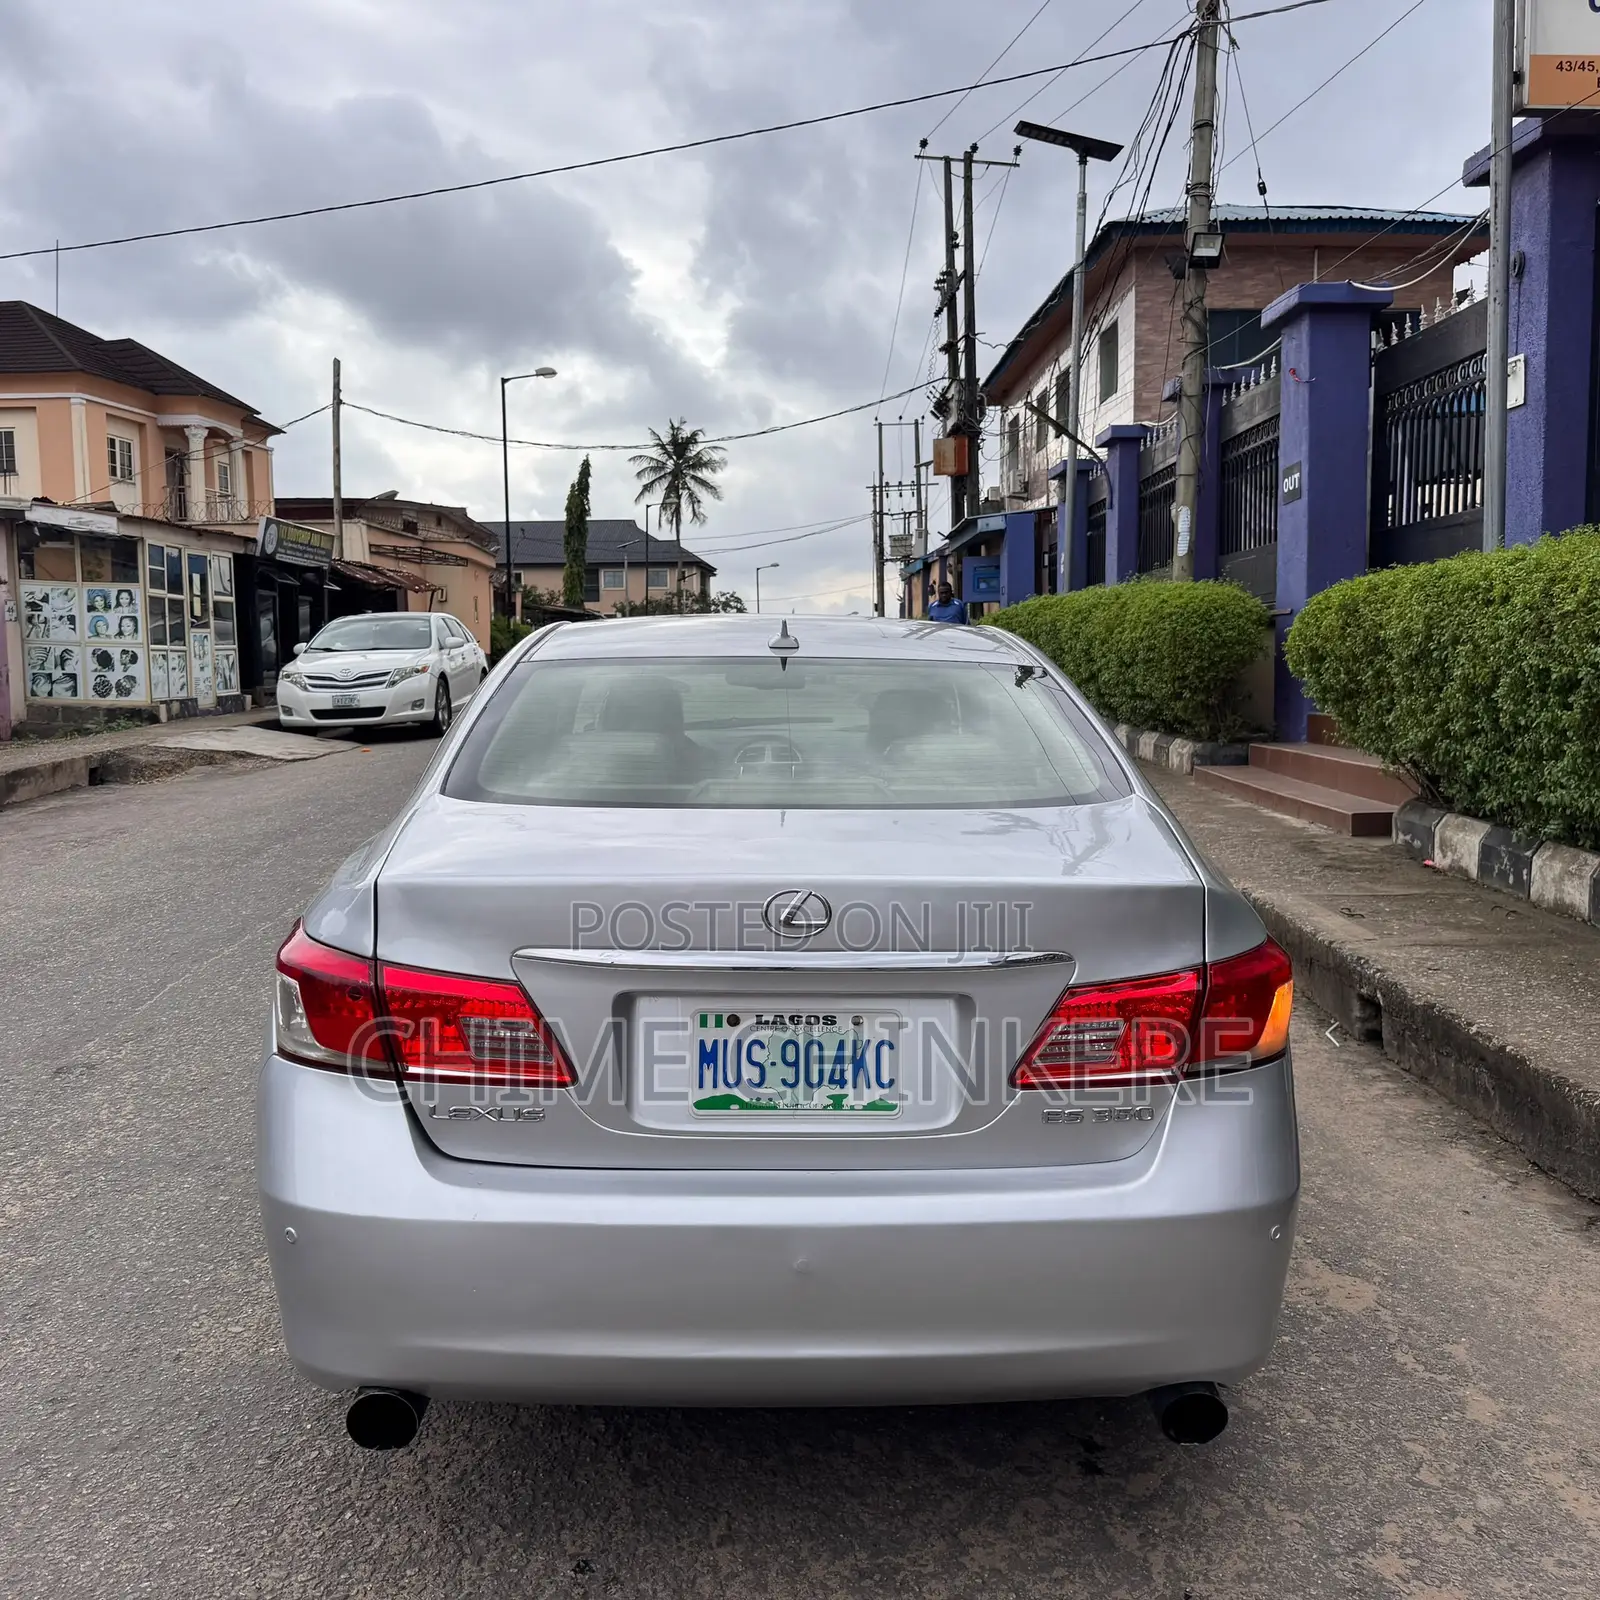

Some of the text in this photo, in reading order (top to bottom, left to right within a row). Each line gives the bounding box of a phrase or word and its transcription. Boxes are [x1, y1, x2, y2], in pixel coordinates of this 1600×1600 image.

[1555, 60, 1599, 74] 43/45,
[1283, 472, 1300, 493] OUT
[755, 1014, 837, 1026] LAGOS
[428, 1104, 546, 1122] LEXUS
[1042, 1106, 1155, 1124] ES 350
